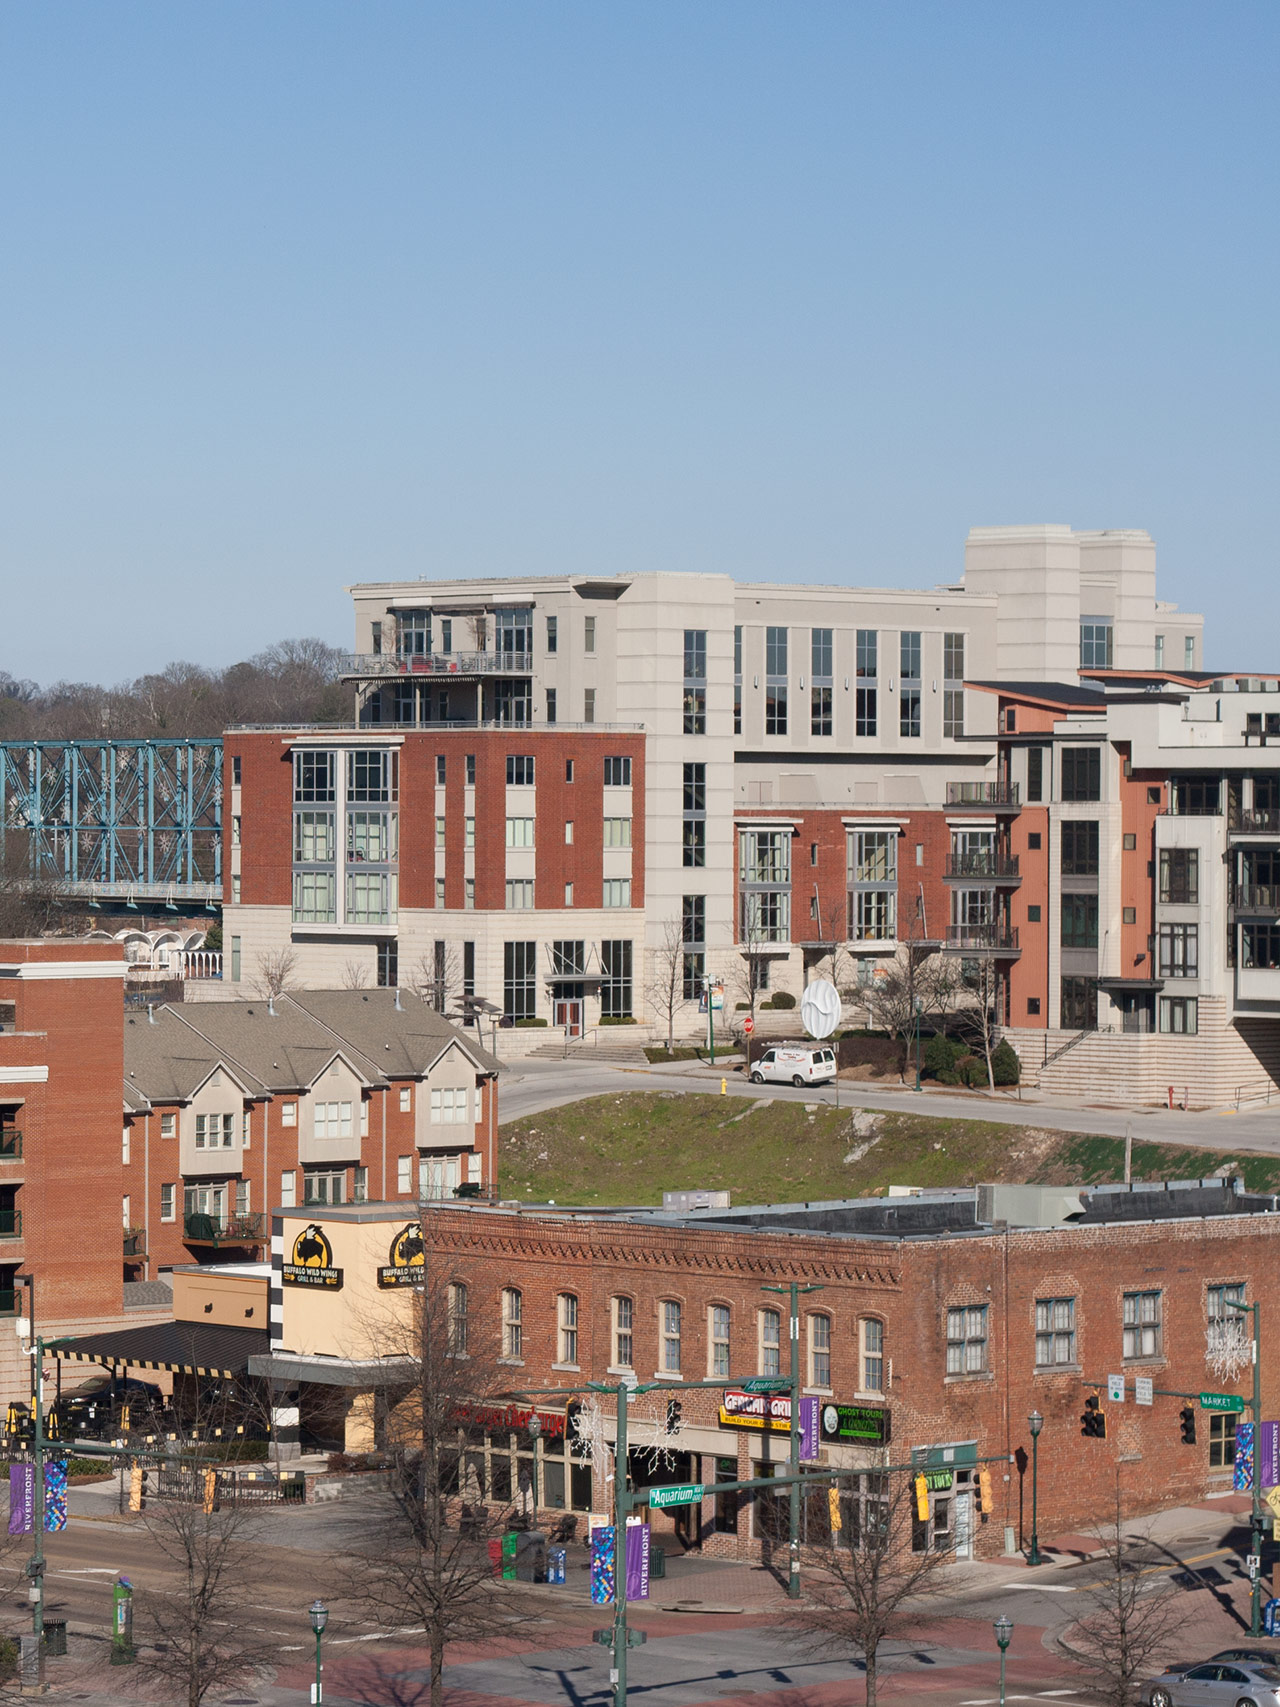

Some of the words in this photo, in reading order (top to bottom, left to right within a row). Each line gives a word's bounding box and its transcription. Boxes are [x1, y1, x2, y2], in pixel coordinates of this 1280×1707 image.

[283, 1265, 305, 1275] BUFFALO
[306, 1267, 320, 1276] WILD
[320, 1269, 337, 1278] WINGS
[382, 1267, 409, 1277] BUFFALO
[1201, 1396, 1231, 1407] MARKET
[838, 1407, 859, 1417] GHOST
[861, 1409, 883, 1419] TOURS
[725, 1415, 742, 1423] BUILD
[743, 1417, 759, 1426] YOUR
[654, 1487, 693, 1506] Aquarium
[641, 1527, 649, 1596] RIVERFRONT
